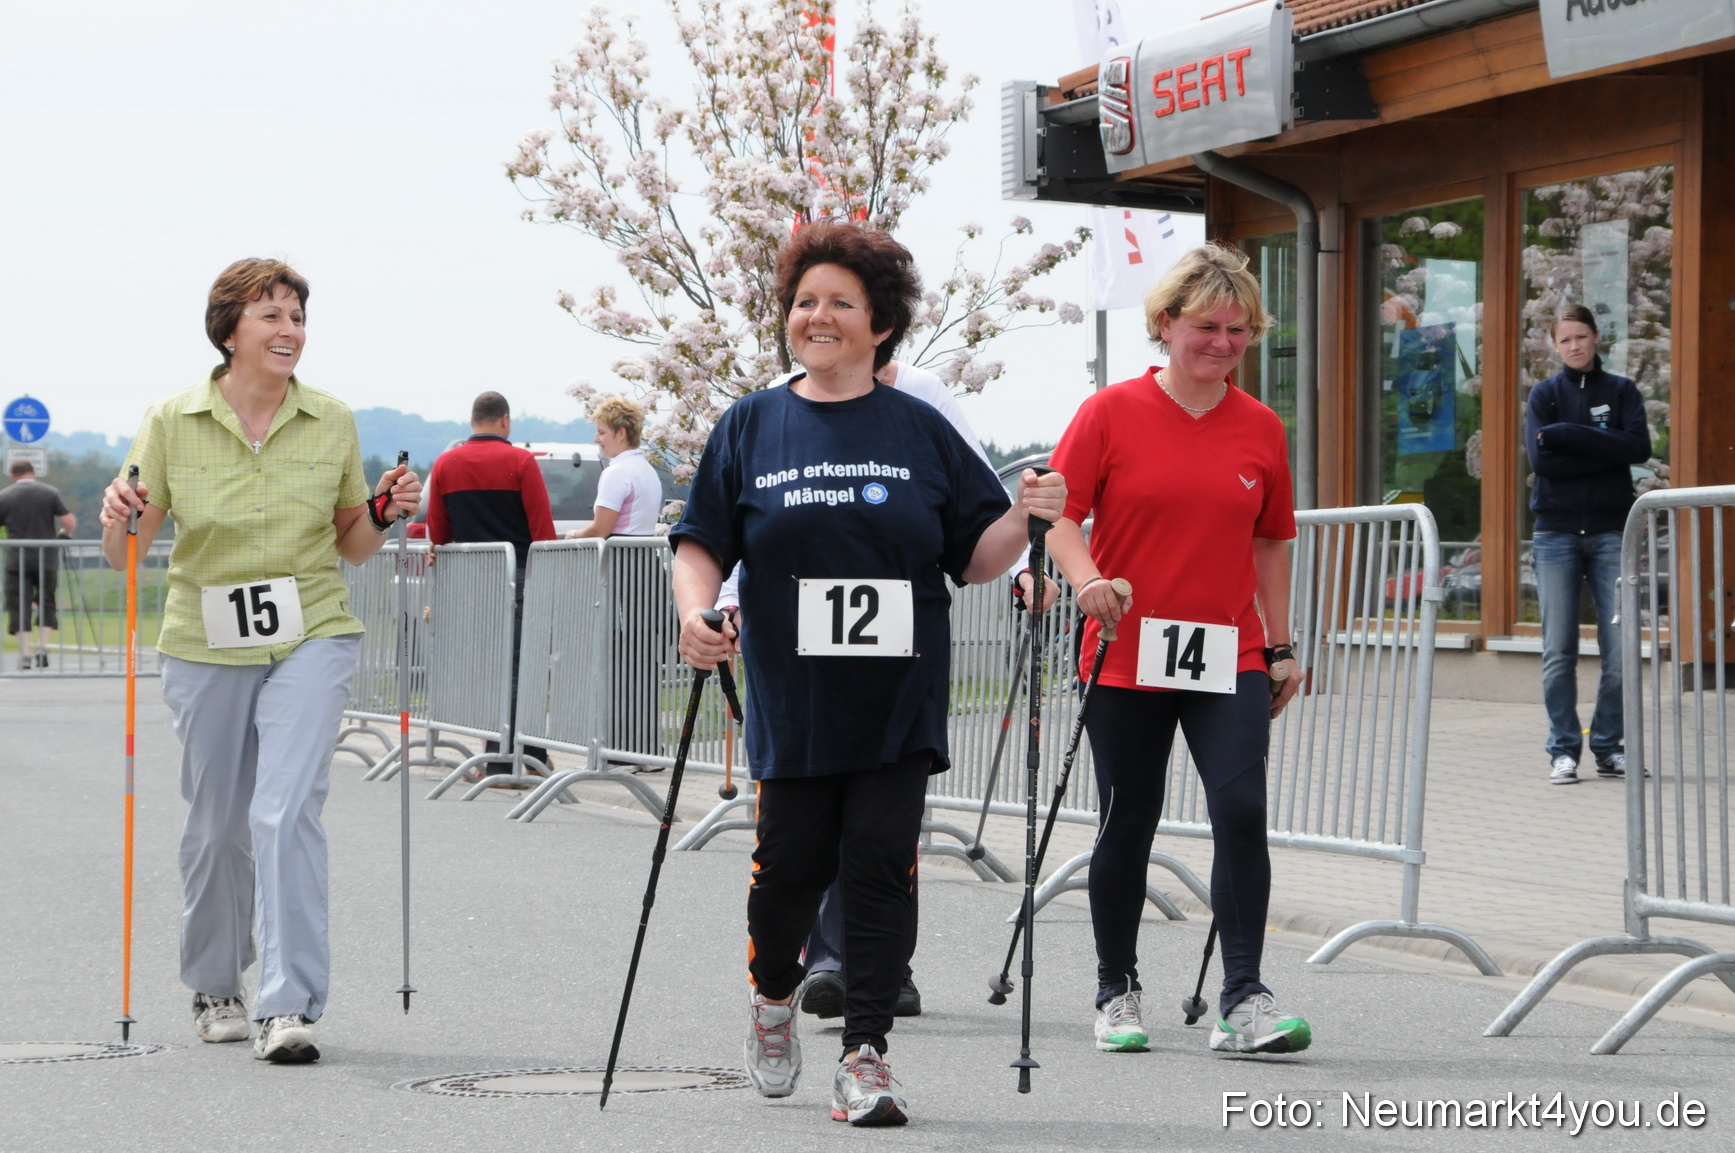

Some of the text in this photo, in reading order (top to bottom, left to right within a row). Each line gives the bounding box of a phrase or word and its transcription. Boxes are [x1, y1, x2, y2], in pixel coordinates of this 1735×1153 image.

[1152, 47, 1252, 118] SEAT
[754, 460, 911, 489] ohne erkennbare
[783, 483, 855, 508] Mängel
[228, 584, 280, 638] 15
[825, 584, 879, 645] 12
[1162, 624, 1207, 681] 14
